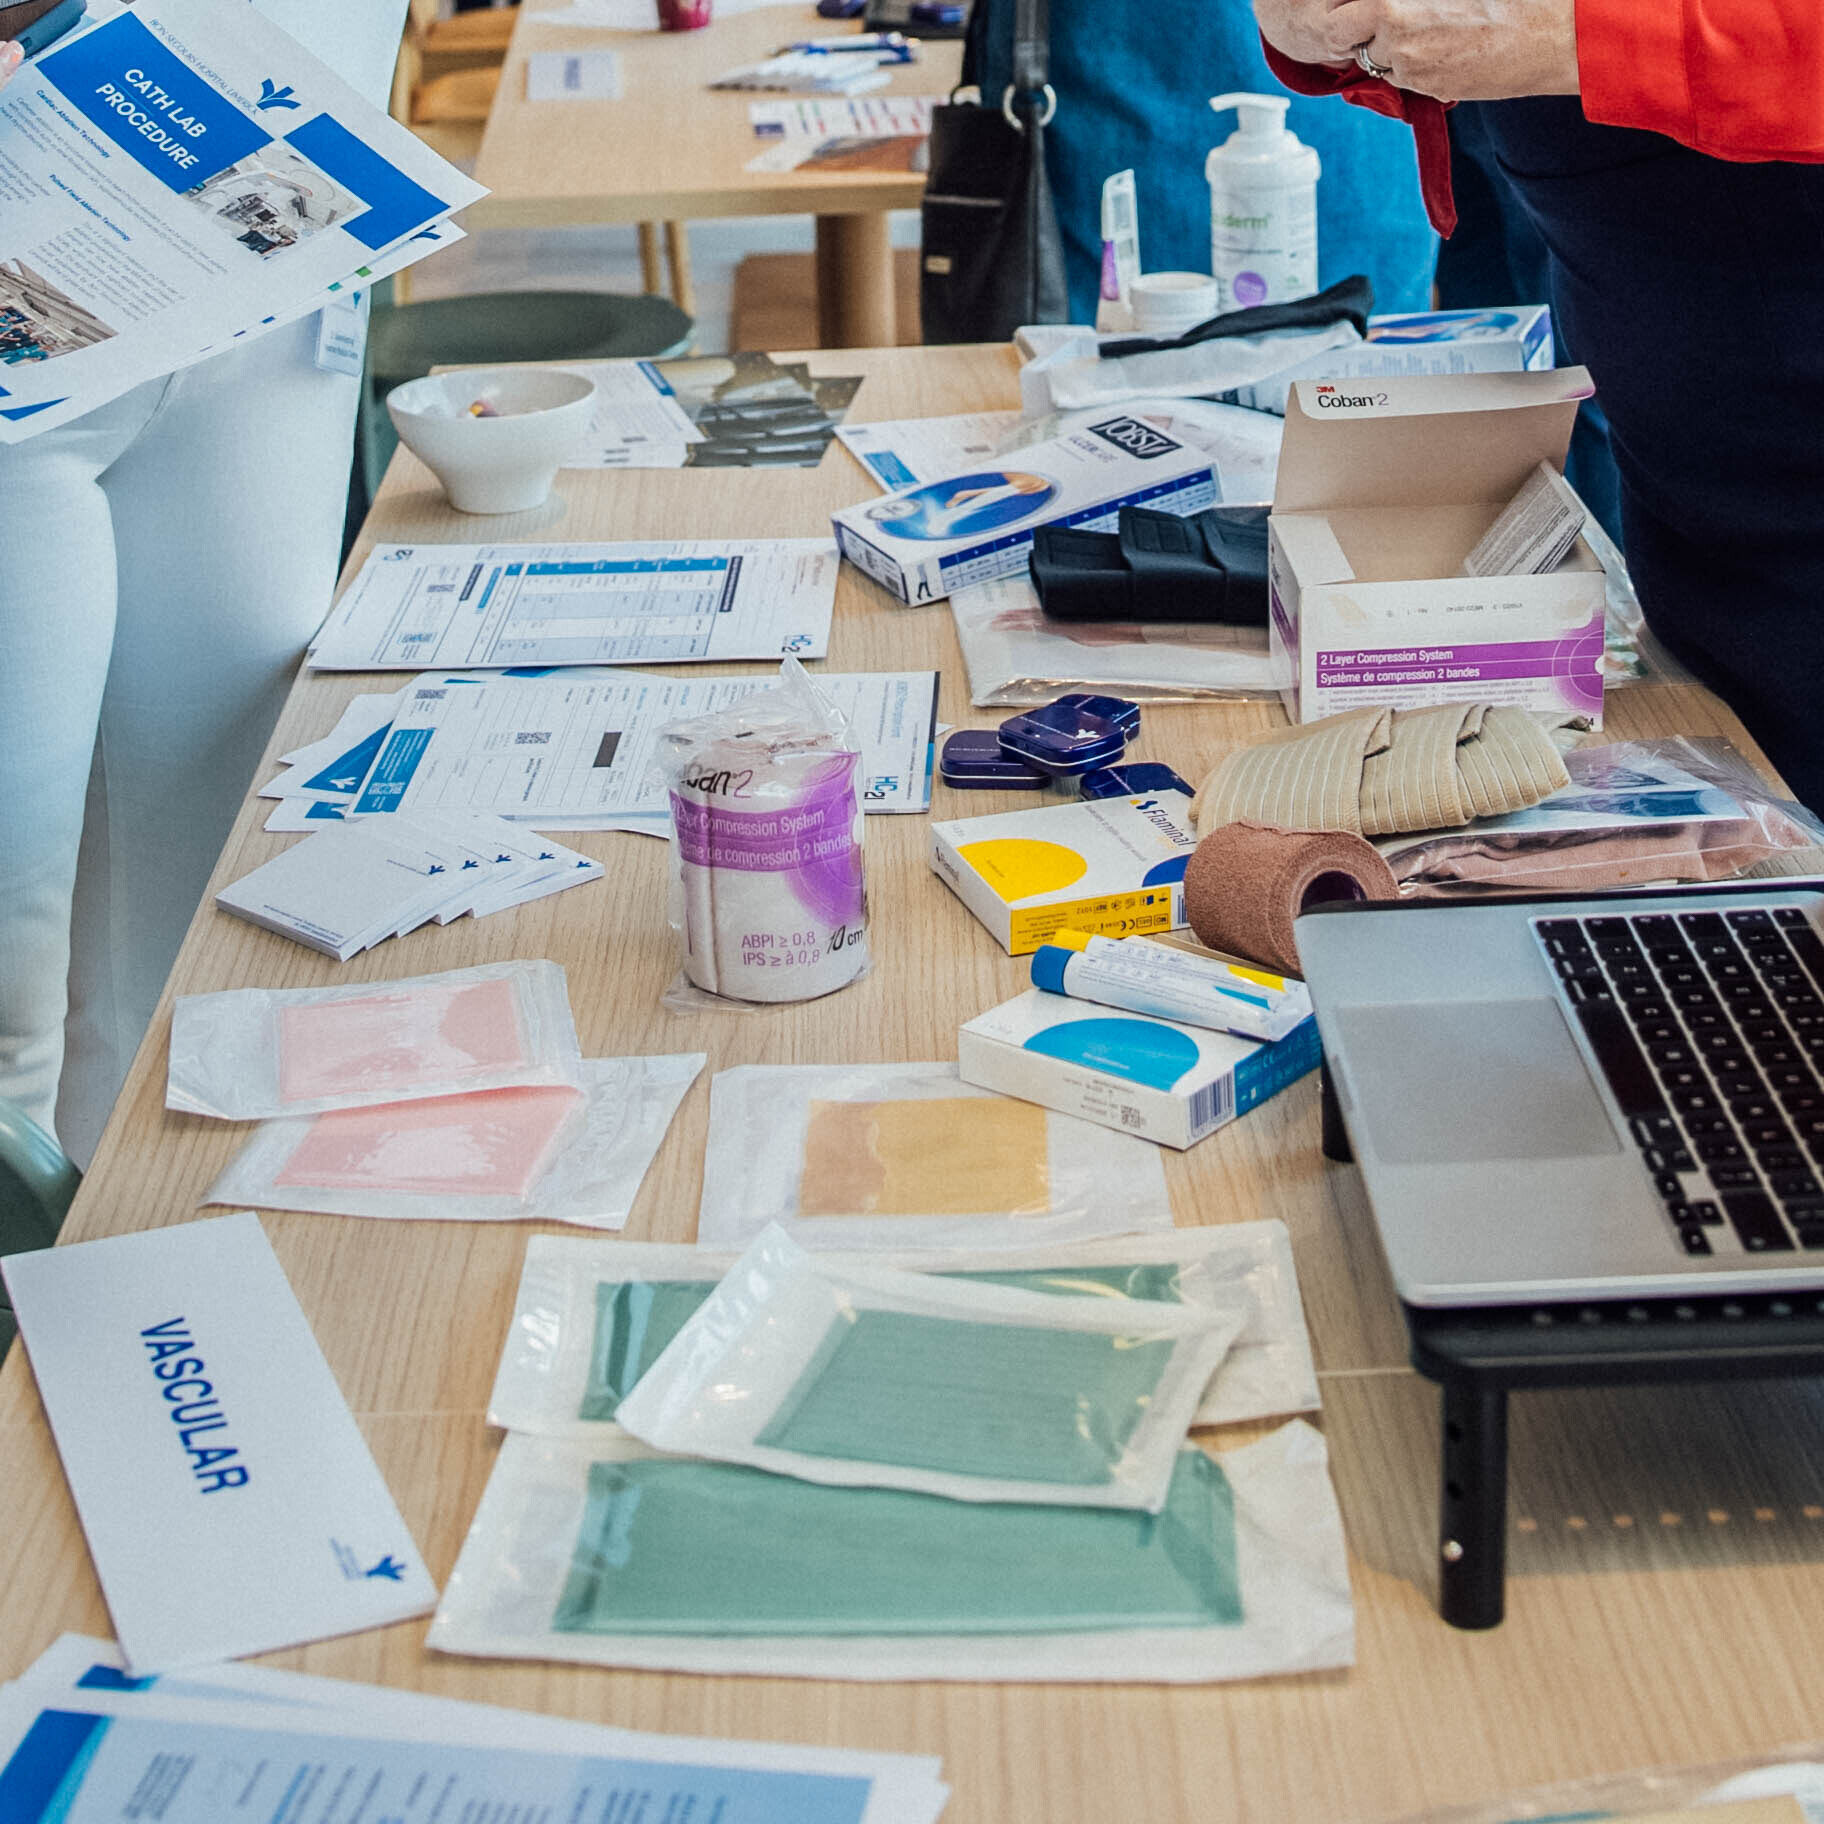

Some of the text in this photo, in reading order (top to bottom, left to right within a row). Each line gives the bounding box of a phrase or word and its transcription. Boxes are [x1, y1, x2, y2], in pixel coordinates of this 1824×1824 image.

[125, 69, 207, 138] CATH LAB
[95, 83, 200, 170] PROCEDURE
[1316, 386, 1335, 394] 3M
[1317, 394, 1373, 409] Coban
[1095, 417, 1177, 455] JOBST
[1320, 649, 1454, 667] 2 Layer Compression System
[1320, 666, 1480, 686] Système de compression 2 bandes
[700, 811, 778, 837] Compression
[780, 809, 825, 835] System
[1142, 809, 1197, 846] Flaminal
[725, 845, 801, 868] compression
[803, 844, 811, 858] 2
[813, 833, 852, 856] bandes
[741, 933, 775, 949] ABPI
[792, 931, 816, 947] 0,8
[826, 925, 863, 955] 10 cm
[743, 951, 766, 967] IPS
[797, 950, 821, 967] 0,8
[139, 1316, 250, 1495] VASCULAR
